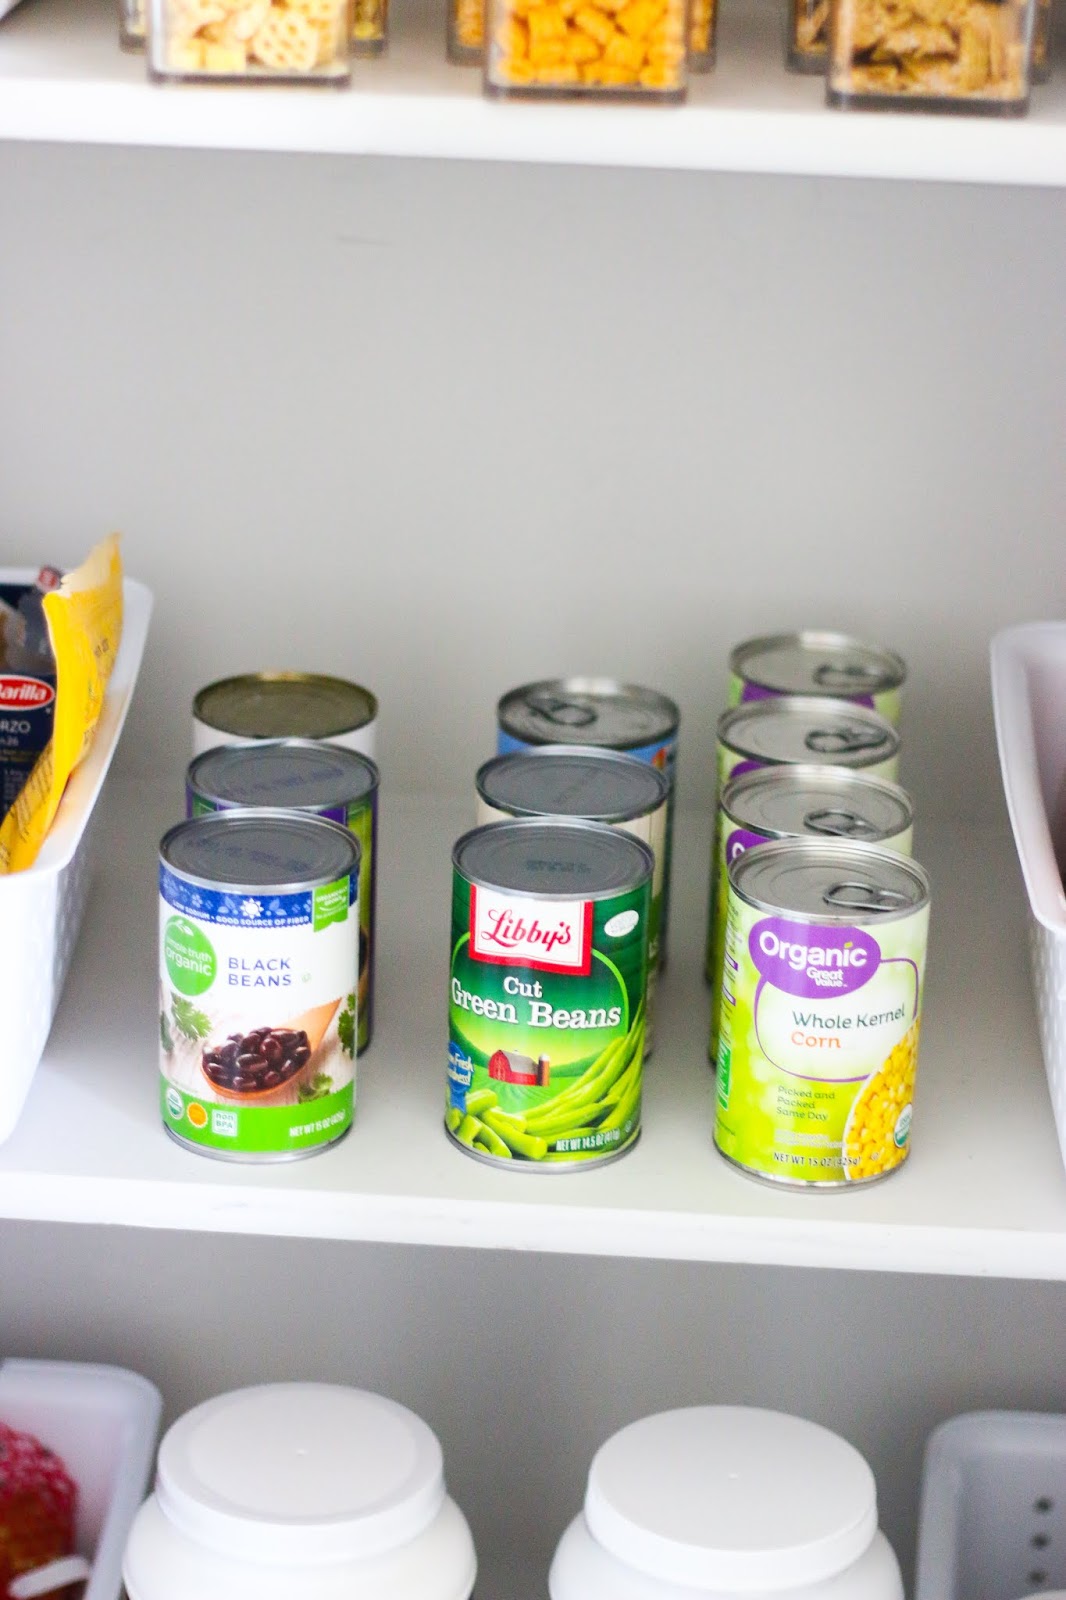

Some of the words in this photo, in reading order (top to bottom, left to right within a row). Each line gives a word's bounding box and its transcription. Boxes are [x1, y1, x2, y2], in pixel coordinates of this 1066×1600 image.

[216, 915, 240, 926] GOOD
[240, 918, 273, 927] SOURCE
[274, 918, 286, 926] OF
[286, 915, 309, 925] FIBER
[481, 908, 571, 952] Libby's
[187, 948, 212, 963] truth
[759, 930, 868, 971] Organic
[165, 945, 212, 977] organic
[228, 957, 291, 971] BLACK
[228, 973, 291, 987] BEANS
[806, 967, 844, 981] Great
[503, 976, 543, 998] Cut
[815, 978, 843, 987] Value
[451, 977, 519, 1024] Green
[527, 1000, 622, 1029] Beans
[792, 1010, 852, 1029] Whole
[856, 1003, 906, 1028] Kernel
[791, 1031, 842, 1049] Corn
[777, 1085, 813, 1099] Picked
[814, 1091, 836, 1100] and
[777, 1096, 816, 1109] Packed
[216, 1112, 234, 1121] non
[776, 1106, 806, 1119] Same
[807, 1110, 829, 1121] Day
[216, 1120, 233, 1129] BPA
[289, 1125, 303, 1137] NET
[303, 1122, 315, 1135] WT
[556, 1139, 569, 1152] NET
[569, 1138, 582, 1151] WT
[582, 1135, 596, 1149] 14.5
[595, 1133, 604, 1146] OZ
[774, 1152, 790, 1163] NET
[791, 1155, 805, 1165] WT
[808, 1157, 818, 1167] 15
[820, 1157, 832, 1167] OZ
